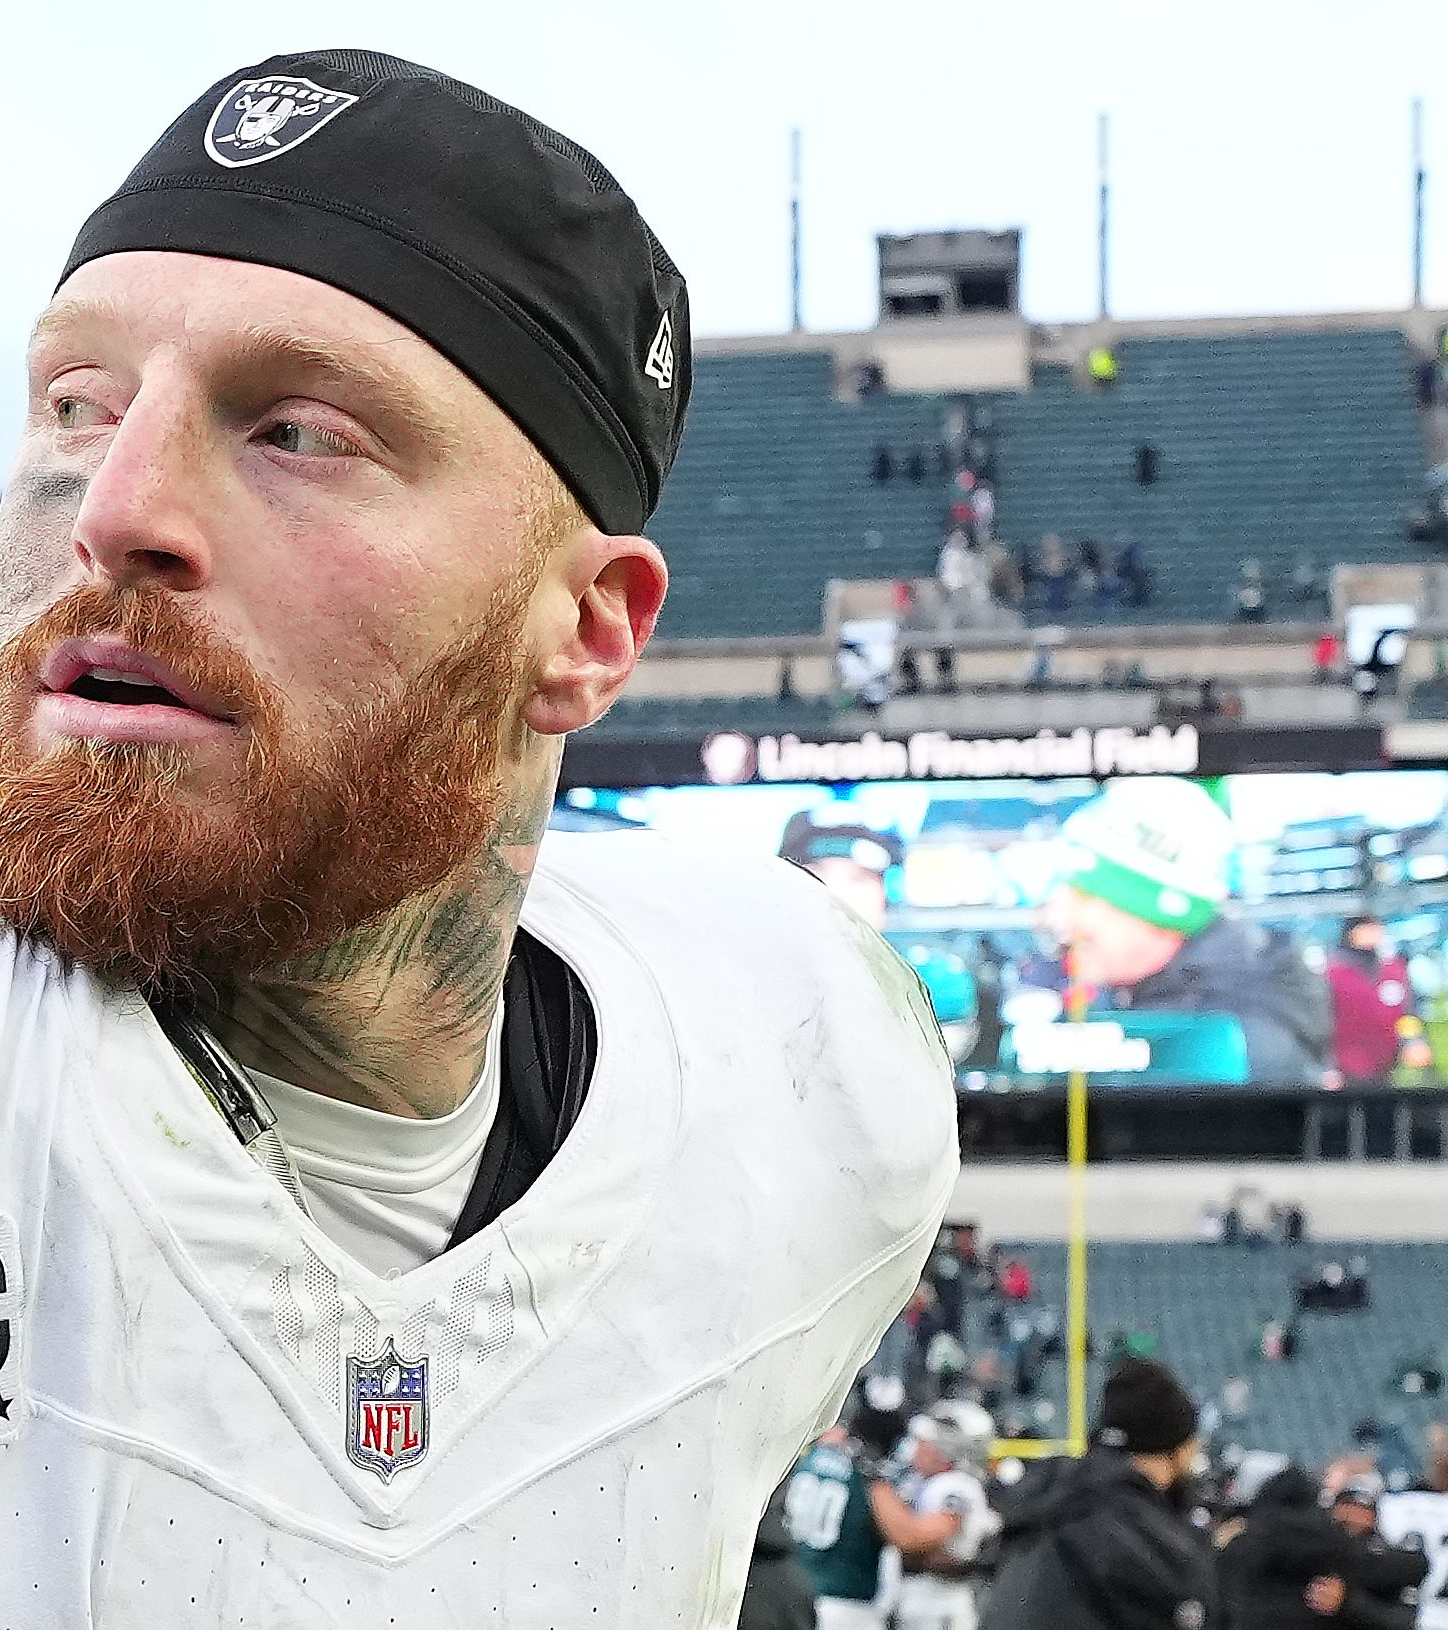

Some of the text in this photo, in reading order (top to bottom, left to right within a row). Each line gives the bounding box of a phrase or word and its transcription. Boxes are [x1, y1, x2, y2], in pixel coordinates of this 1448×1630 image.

[244, 82, 338, 104] RAIDERS
[757, 723, 1199, 781] Lincoln Financial Field
[361, 1403, 419, 1457] NFL
